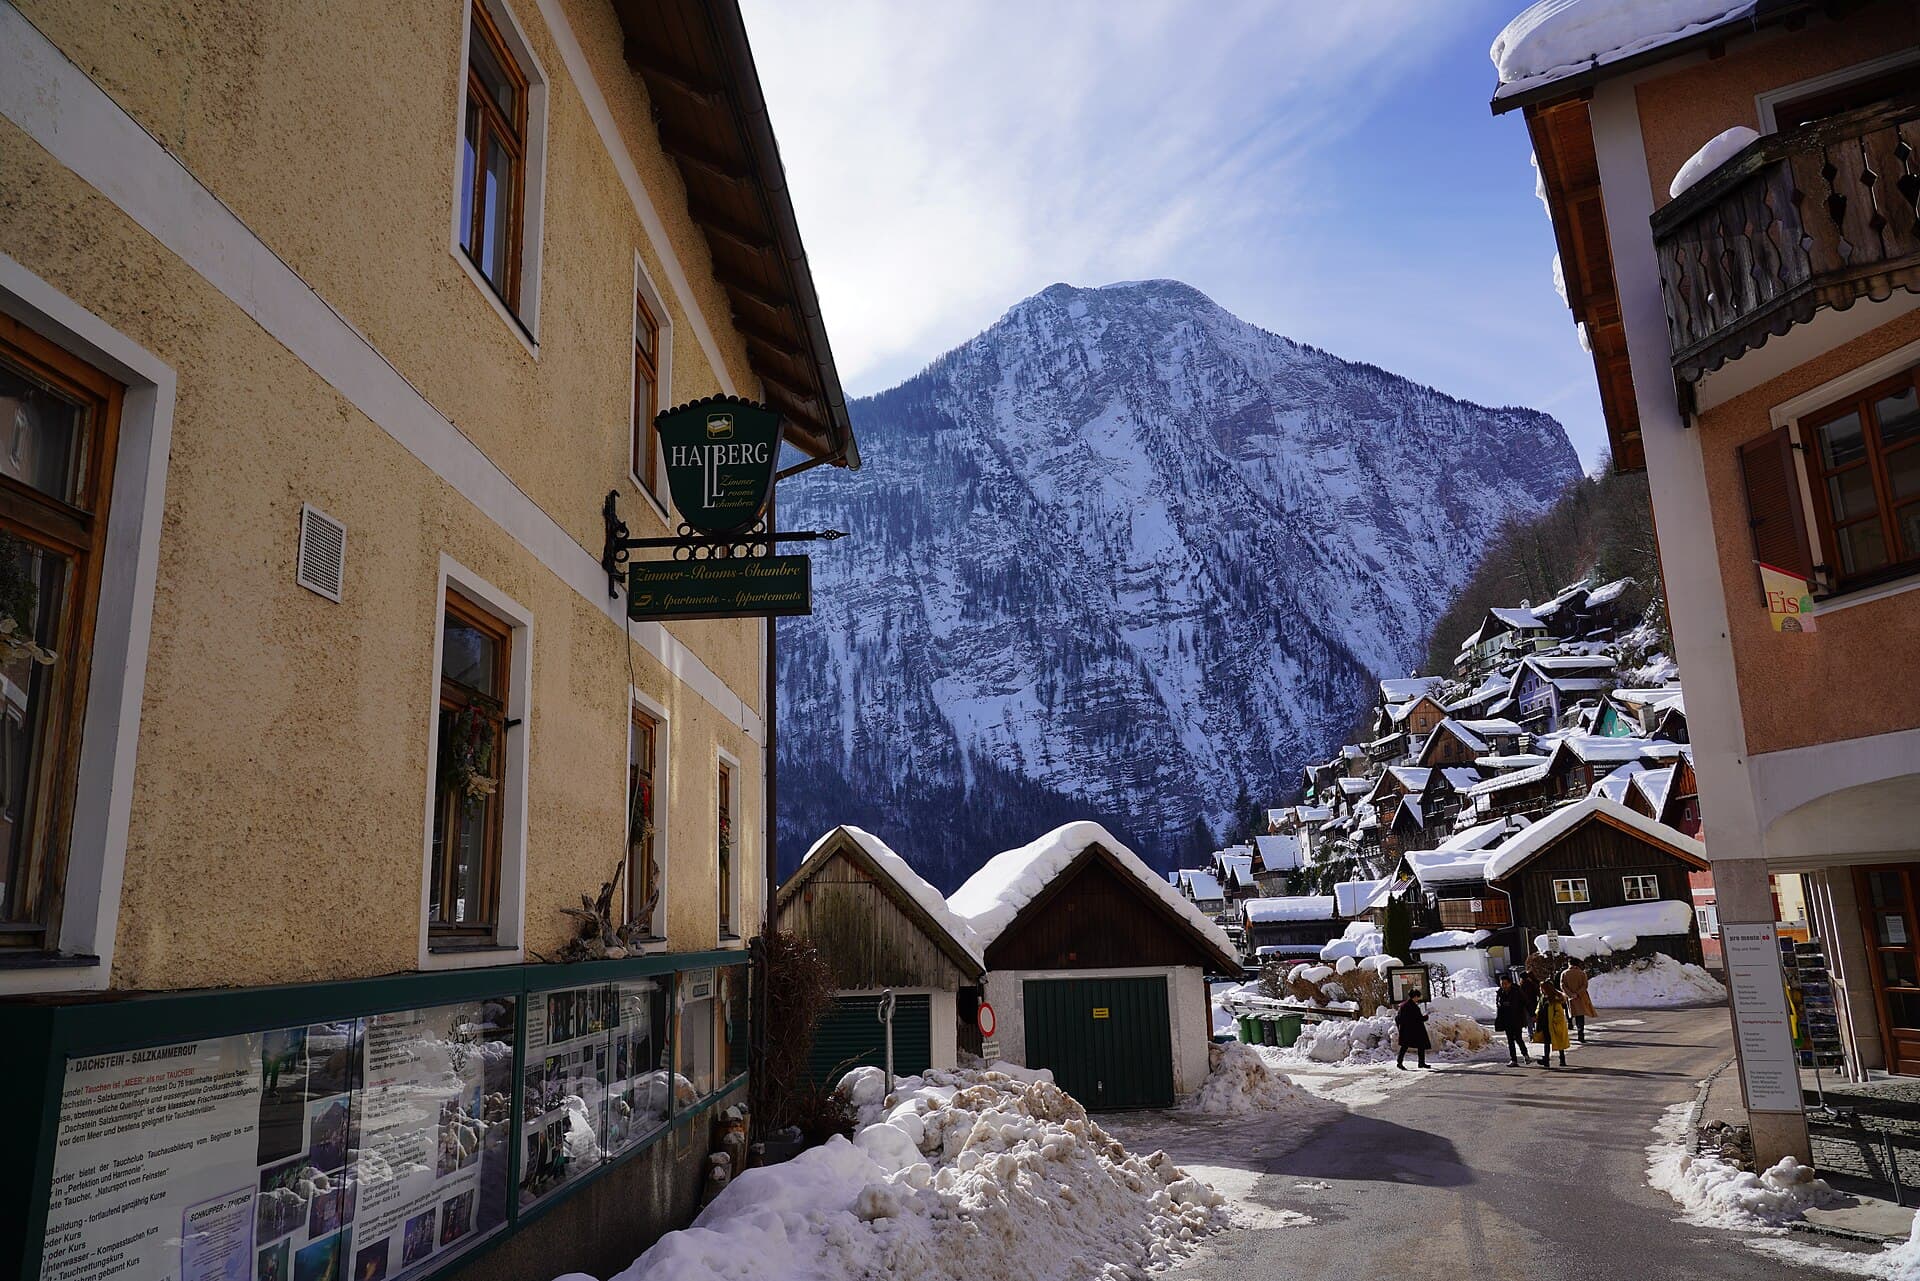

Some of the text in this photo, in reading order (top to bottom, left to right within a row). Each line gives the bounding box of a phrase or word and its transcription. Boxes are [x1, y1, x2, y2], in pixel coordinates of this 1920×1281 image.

[719, 474, 756, 487] Zimmer
[1766, 590, 1800, 614] Eis
[76, 1045, 197, 1072] DACHSTEIN SALZKAMMERGUT
[85, 1082, 111, 1093] Tauchen
[59, 1138, 72, 1147] vor
[71, 1134, 86, 1144] dem
[86, 1131, 102, 1140] Meer
[103, 1127, 116, 1136] und
[117, 1122, 140, 1133] bestens
[79, 1166, 96, 1177] bietet
[99, 1163, 109, 1172] der
[113, 1153, 144, 1167] Tauchclub
[148, 1141, 193, 1159] Tauchausbildung
[101, 1174, 112, 1183] und
[128, 1177, 141, 1185] vom
[89, 1205, 120, 1222] fortlaufend
[149, 1191, 166, 1202] Kurse
[64, 1231, 82, 1242] Kurs
[146, 1225, 159, 1236] Kurs
[68, 1241, 86, 1253] Kurs
[126, 1257, 140, 1268] Kurs
